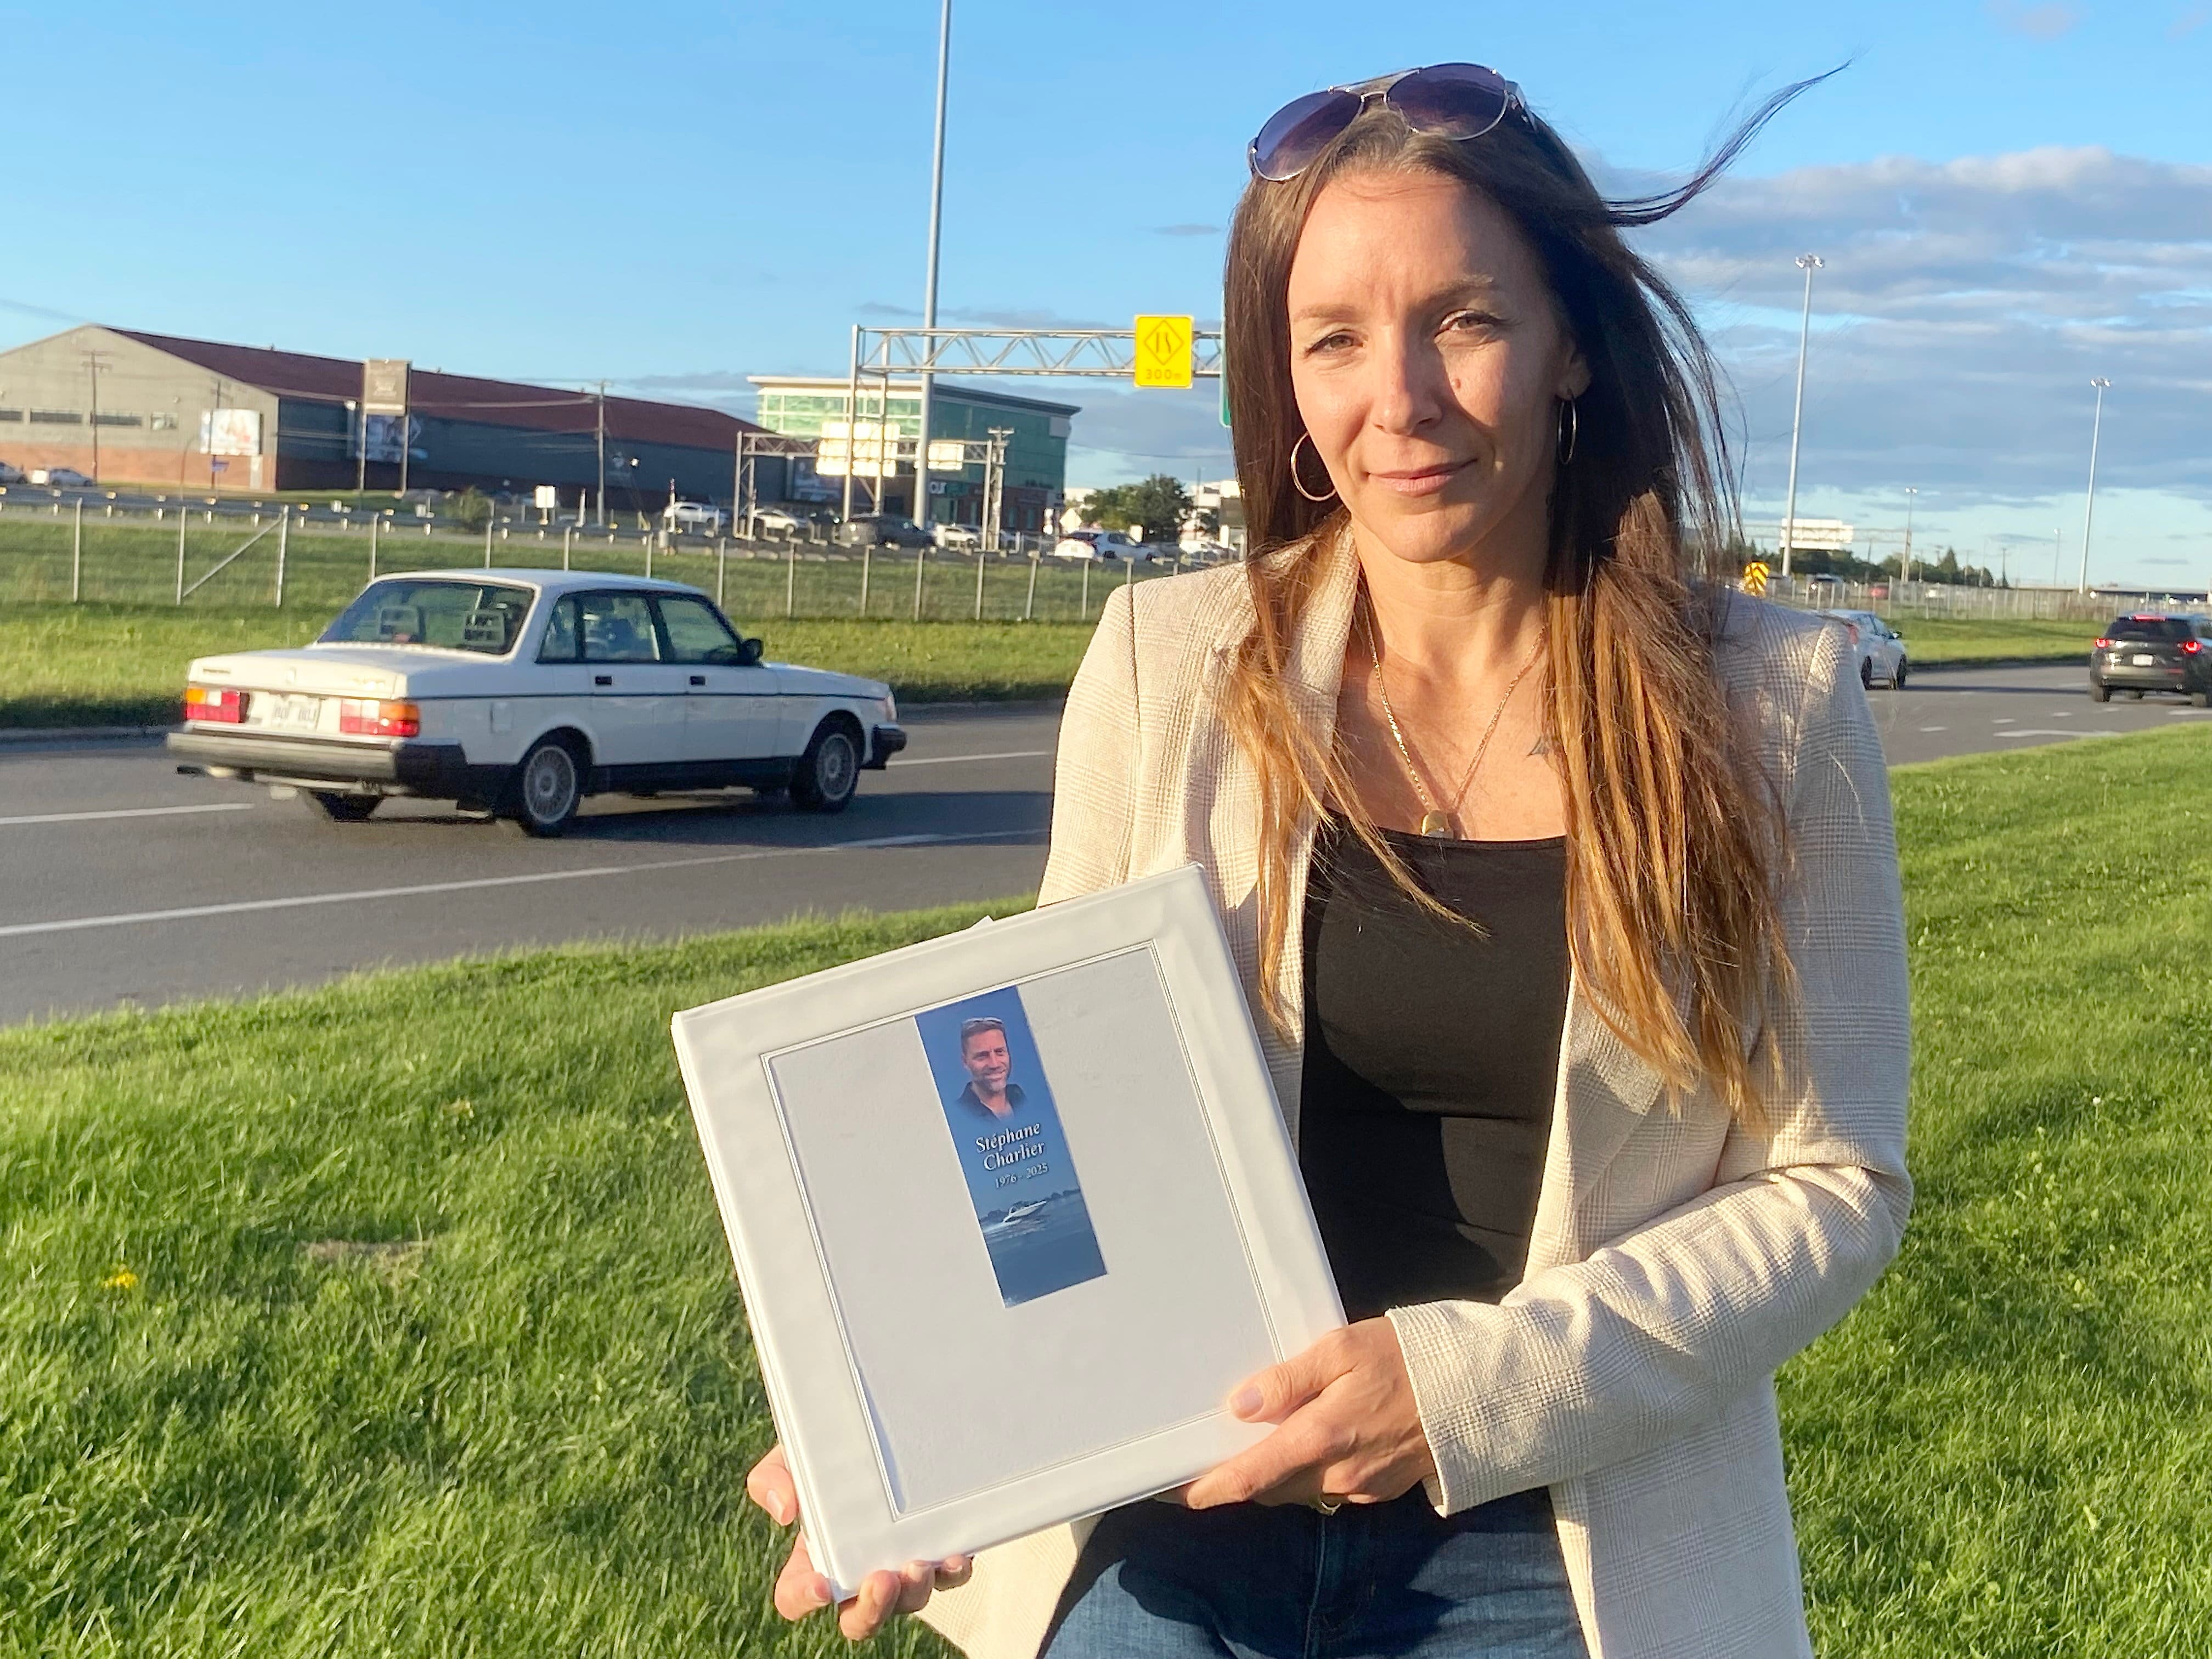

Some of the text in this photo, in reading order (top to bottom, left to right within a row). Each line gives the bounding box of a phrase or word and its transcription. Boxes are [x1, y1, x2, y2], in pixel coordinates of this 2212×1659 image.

[976, 1122, 1040, 1153] Stéphane
[984, 1142, 1045, 1171] Charlier
[995, 1175, 1017, 1188] 1976
[1026, 1163, 1048, 1178] 2025
